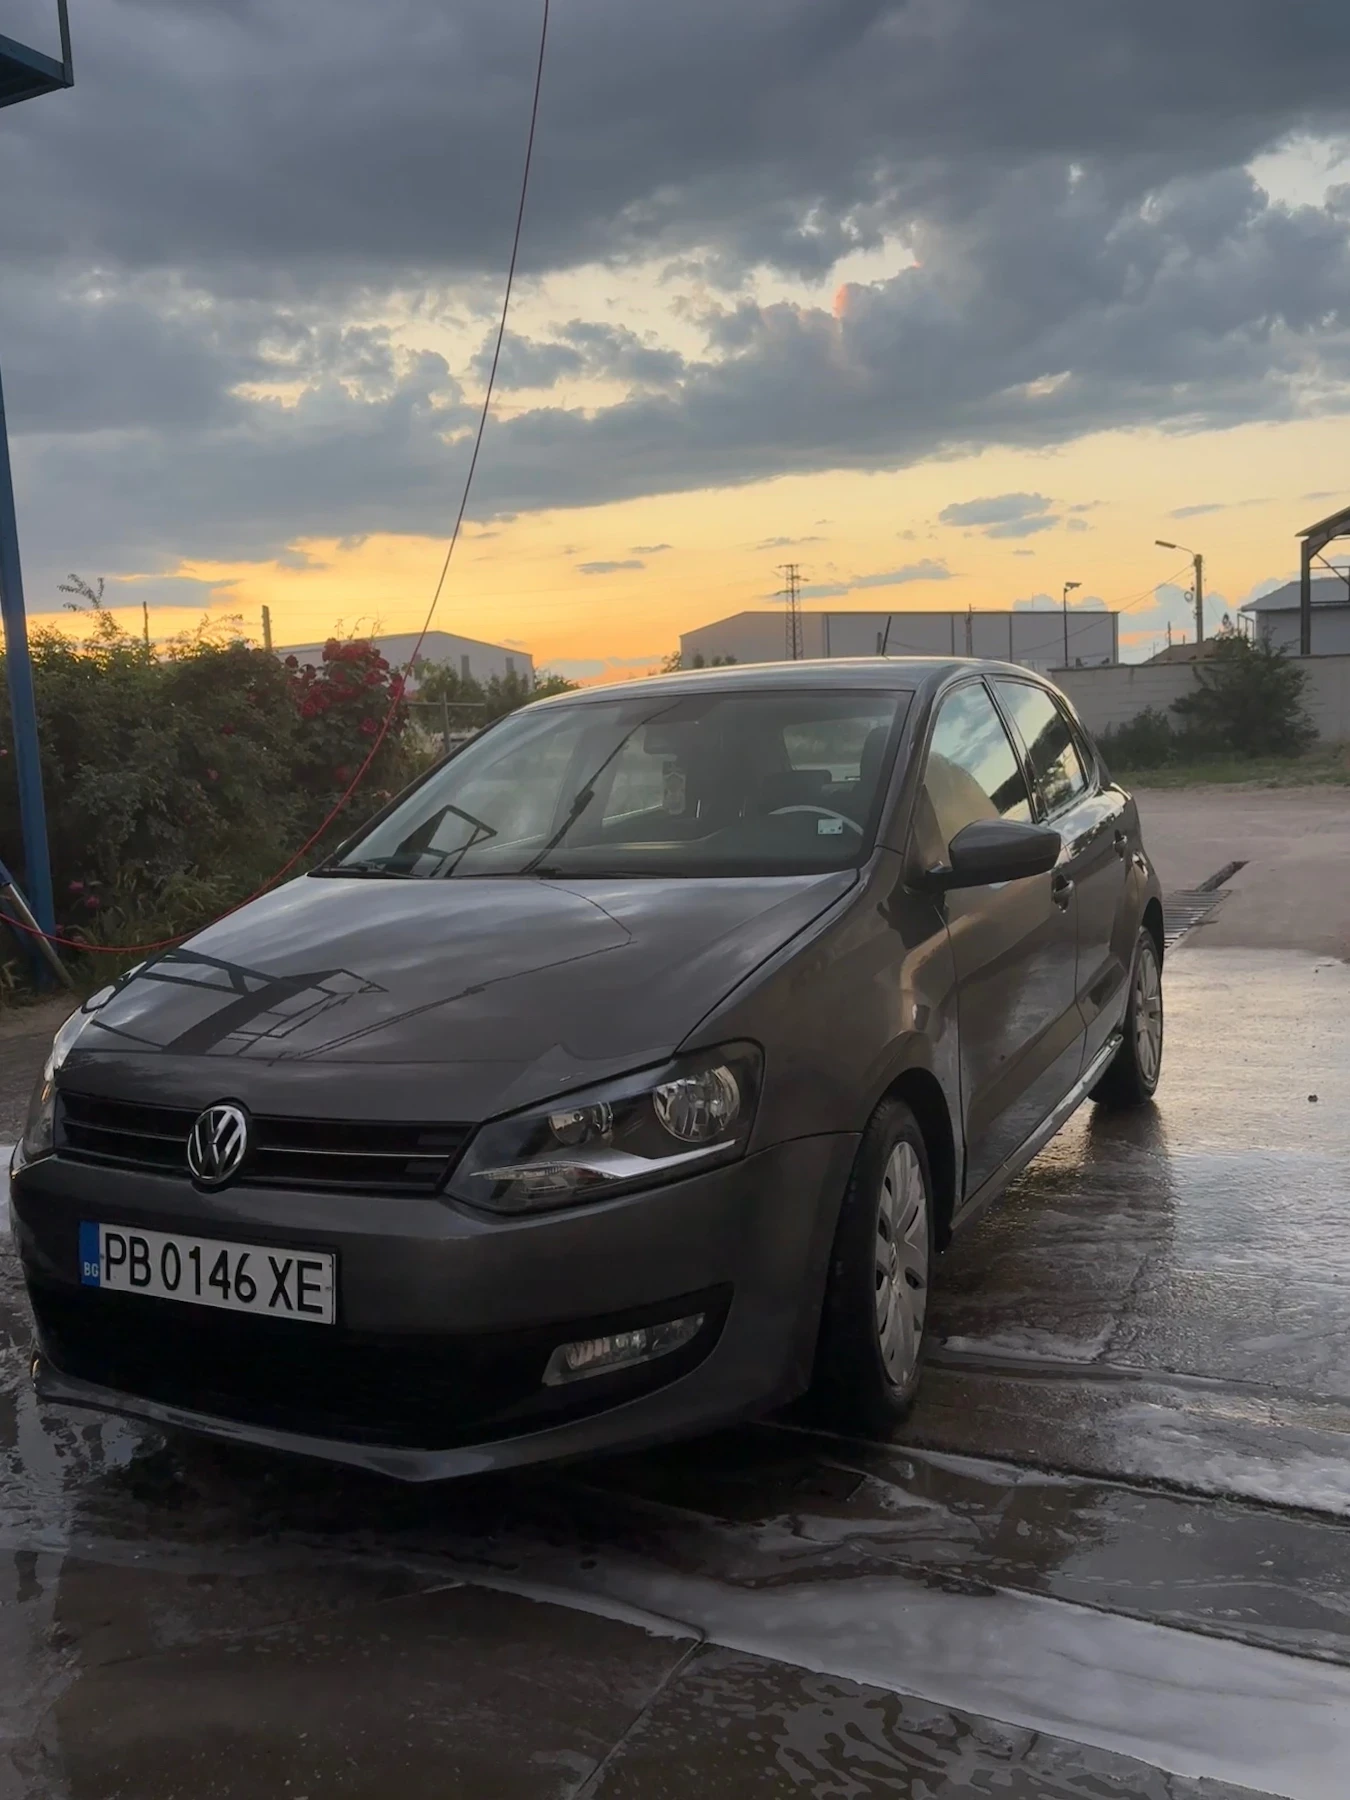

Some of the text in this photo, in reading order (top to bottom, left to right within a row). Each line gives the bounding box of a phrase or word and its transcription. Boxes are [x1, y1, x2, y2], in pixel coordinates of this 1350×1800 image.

[189, 1106, 246, 1181] VW
[84, 1261, 99, 1278] BG
[105, 1232, 323, 1315] PB 0146 XE
